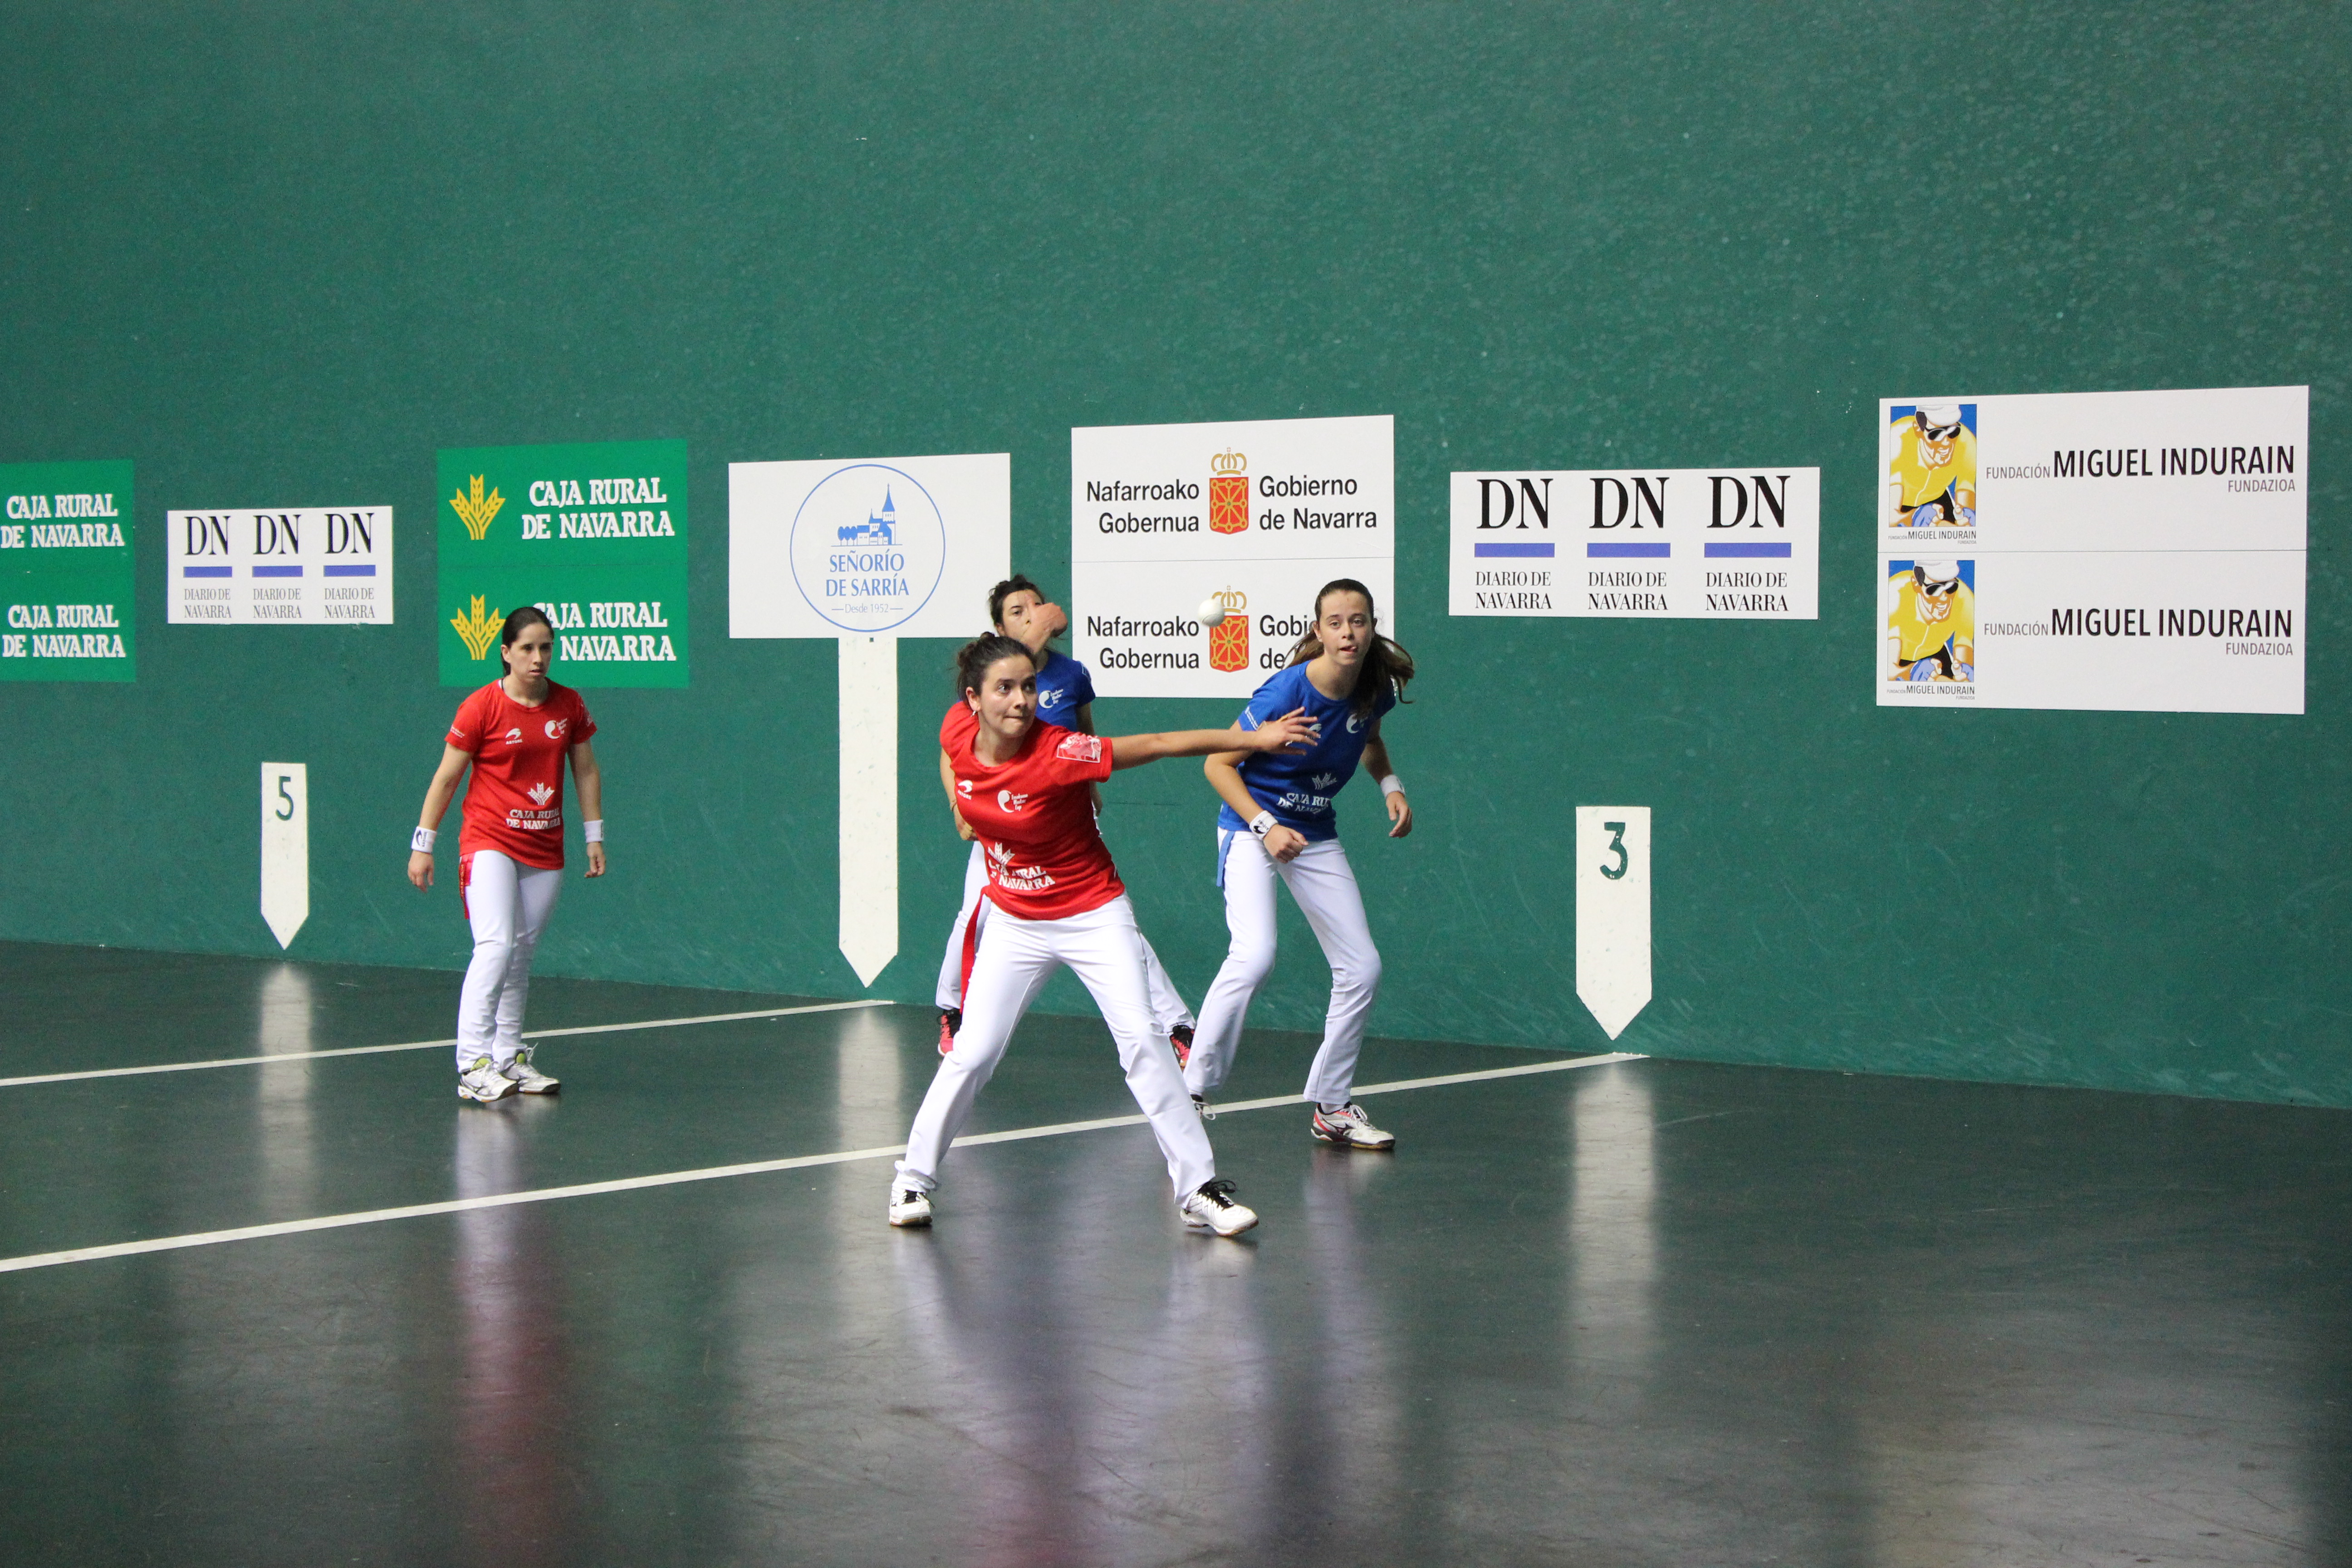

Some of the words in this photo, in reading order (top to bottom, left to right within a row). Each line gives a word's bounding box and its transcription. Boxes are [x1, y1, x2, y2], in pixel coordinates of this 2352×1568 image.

[1986, 463, 2050, 479] FUNDACIÓN
[2053, 448, 2153, 478] MIGUEL
[2161, 445, 2294, 476] INDURAIN
[529, 480, 584, 508] CAJA
[589, 477, 667, 505] RURAL
[1087, 479, 1199, 502] Nafarroako
[1259, 475, 1357, 497] Gobierno
[2228, 479, 2296, 493] FUNDAZIOA
[5, 495, 52, 520] CAJA
[54, 493, 118, 518] RURAL
[1476, 478, 1553, 529] DN
[1589, 477, 1670, 529] DN
[1706, 475, 1791, 528] DN
[522, 514, 551, 539] DE
[559, 510, 675, 539] NAVARRA
[1099, 512, 1199, 534] Gobernua
[1259, 509, 1285, 530] de
[1294, 507, 1377, 530] Navarra
[0, 525, 24, 548] DE
[31, 523, 125, 548] NAVARRA
[184, 515, 231, 555] DN
[253, 514, 301, 555] DN
[324, 513, 374, 554] DN
[1908, 530, 1937, 540] MIGUEL
[1939, 530, 1976, 539] INDURAIN
[830, 549, 904, 572] SEÑORÍO
[826, 579, 847, 597] DE
[851, 573, 909, 596] SARRÍA
[1475, 571, 1528, 586] DIARIO
[1531, 571, 1551, 586] DE
[1588, 572, 1642, 587] DIARIO
[1646, 572, 1667, 587] DE
[1706, 572, 1762, 588] DIARIO
[1765, 572, 1788, 588] DE
[184, 588, 216, 600] DIARIO
[218, 588, 231, 600] DE
[253, 588, 286, 600] DIARIO
[288, 588, 301, 600] DE
[324, 588, 358, 600] DIARIO
[361, 588, 374, 600] DE
[1475, 592, 1553, 609] NAVARRA
[1588, 593, 1669, 611] NAVARRA
[1705, 594, 1789, 612] NAVARRA
[8, 605, 53, 630] CAJA
[56, 604, 119, 628] RURAL
[184, 605, 232, 618] NAVARRA
[253, 605, 302, 618] NAVARRA
[324, 605, 375, 618] NAVARRA
[589, 602, 668, 628] RURAL
[845, 603, 867, 613] Desde
[870, 603, 889, 612] 1952
[1088, 615, 1199, 637] Nafarroako
[1984, 620, 2048, 636] FUNDACIÓN
[2051, 608, 2151, 637] MIGUEL
[2158, 608, 2293, 638] INDURAIN
[2, 634, 27, 657] DE
[32, 634, 126, 658] NAVARRA
[560, 635, 677, 661] NAVARRA
[2225, 642, 2293, 656] FUNDAZIOA
[1100, 647, 1199, 669] Gobernua
[1259, 647, 1285, 669] de
[1906, 685, 1936, 695] MIGUEL
[1937, 685, 1975, 695] INDURAIN
[275, 775, 294, 821] 5
[505, 818, 520, 828] DE
[509, 809, 535, 819] CAJA
[1600, 822, 1628, 880] 3
[999, 874, 1056, 891] NAVARRA
